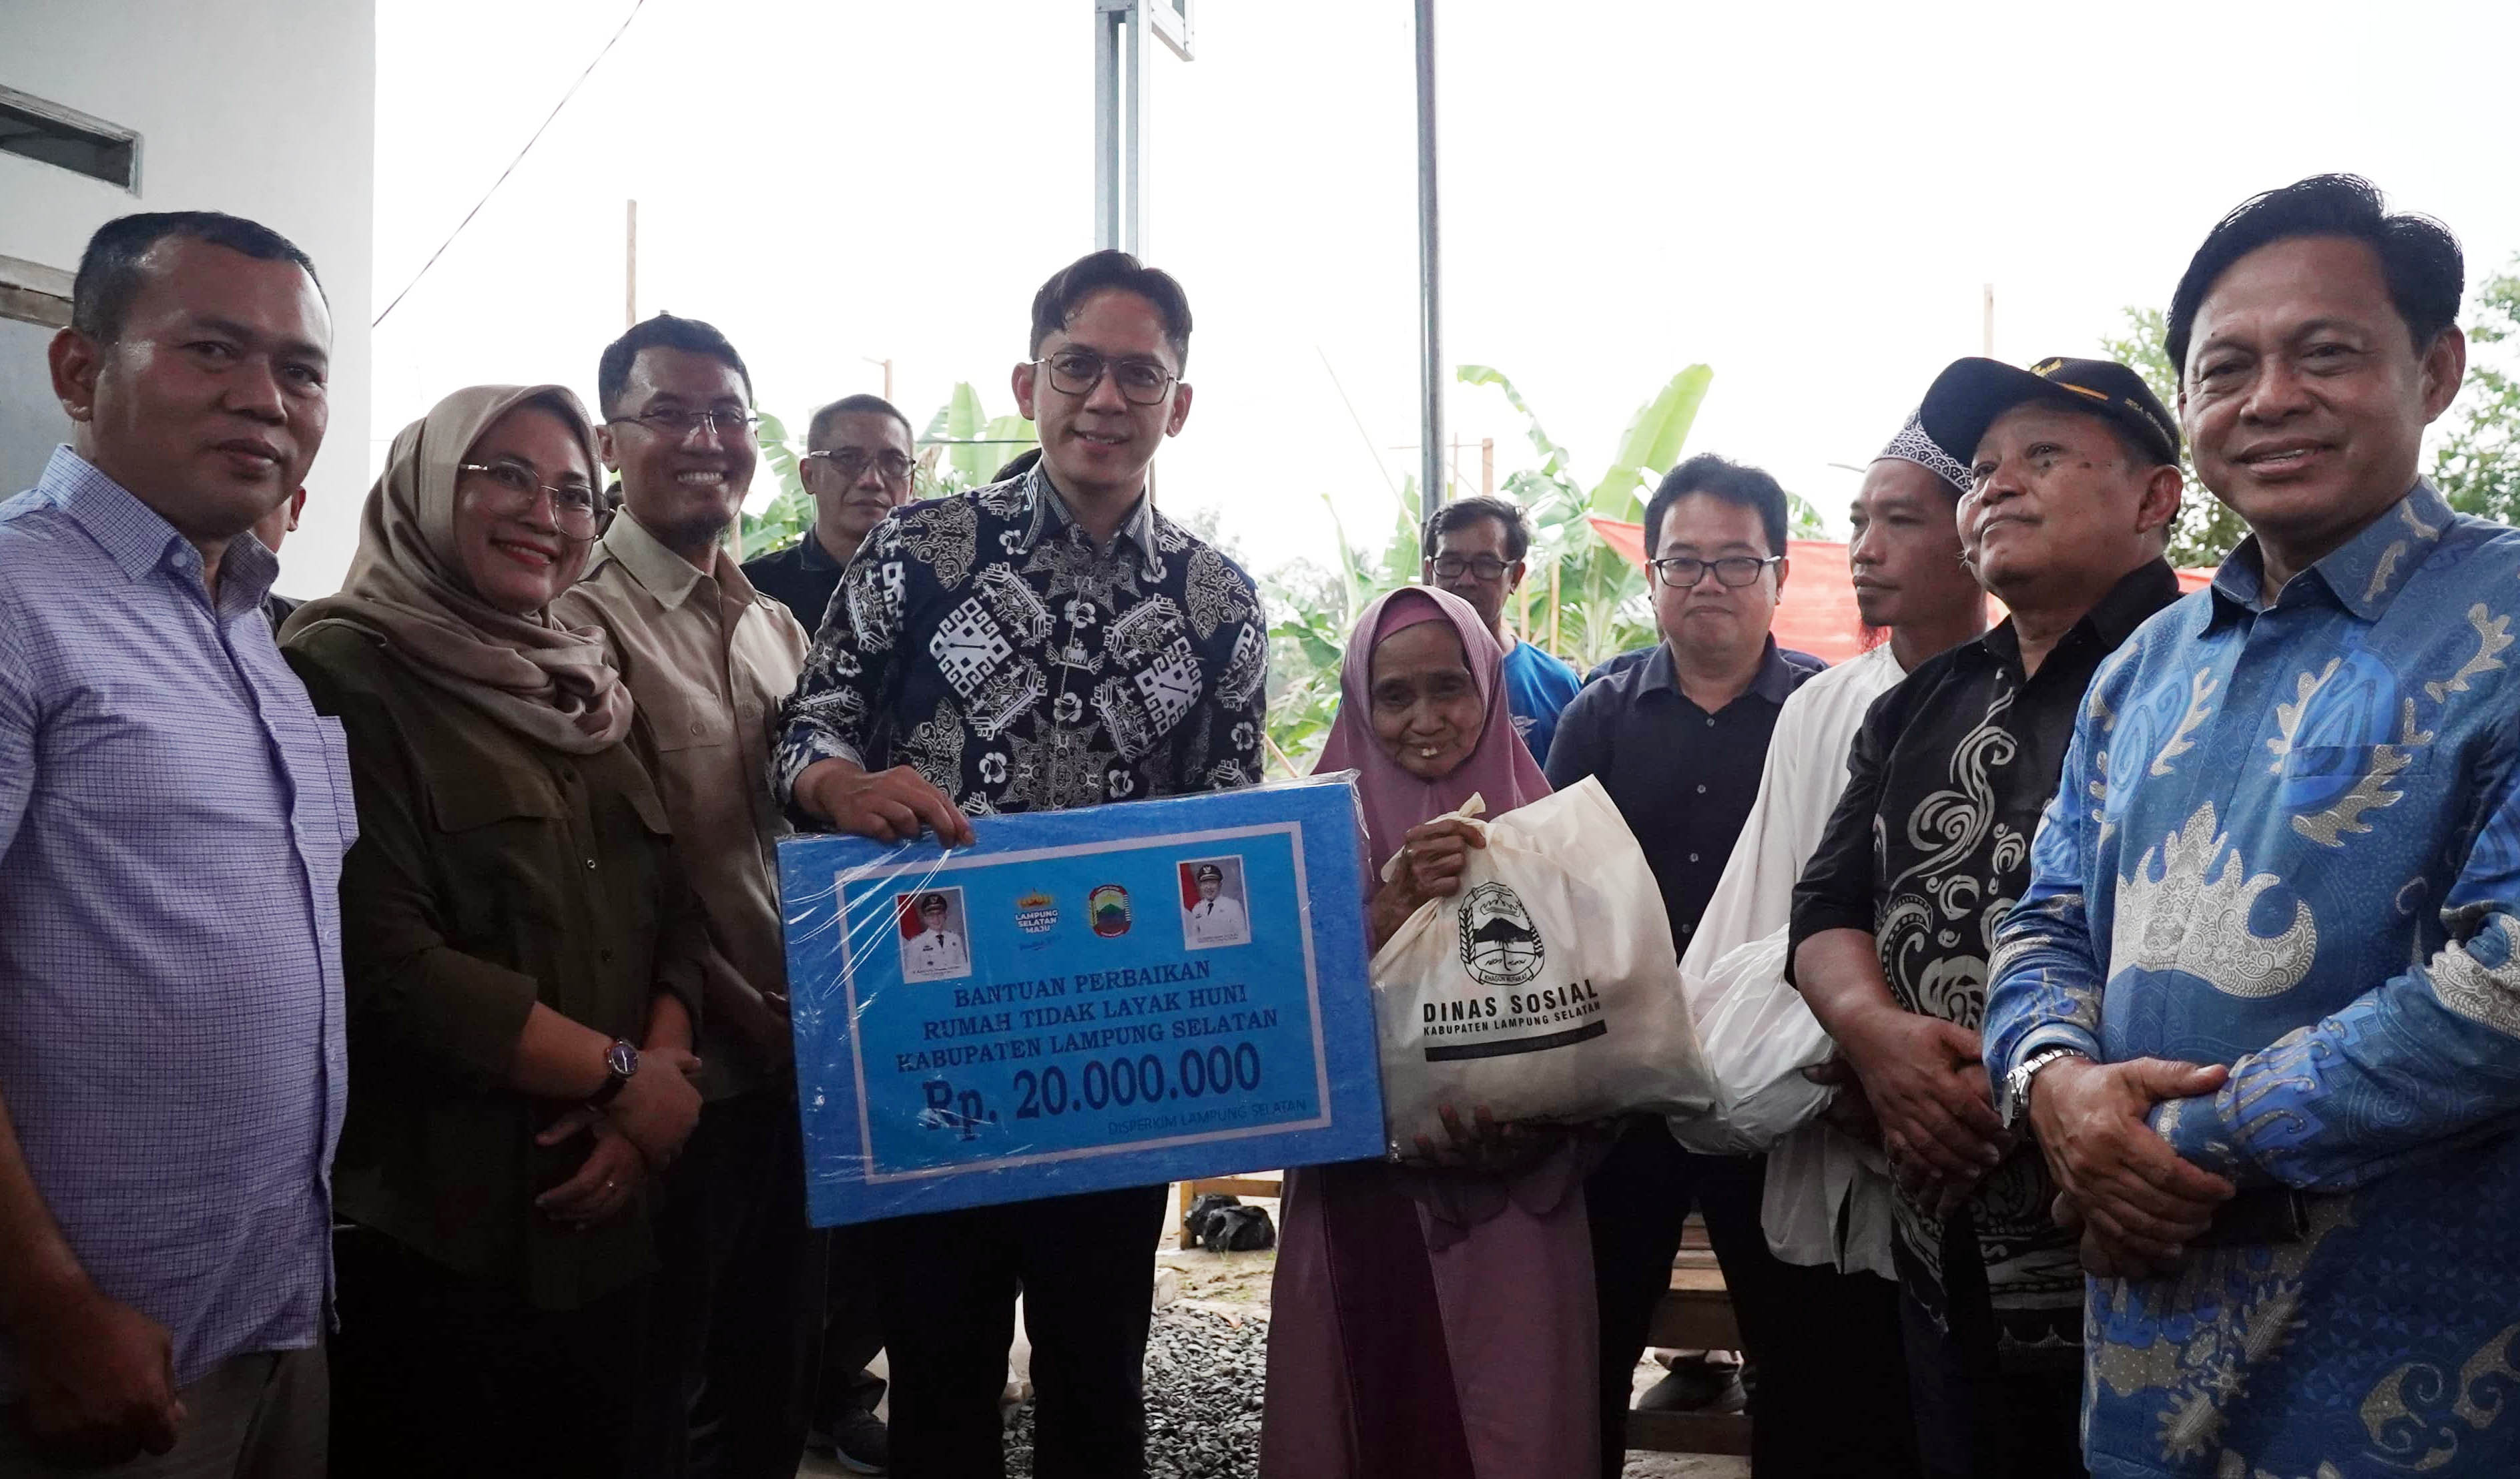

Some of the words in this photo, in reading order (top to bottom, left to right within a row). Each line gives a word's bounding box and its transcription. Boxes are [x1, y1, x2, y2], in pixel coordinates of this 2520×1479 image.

[1014, 909, 1058, 920] LAMPUNG
[1018, 917, 1057, 928] SELATAN
[1025, 925, 1050, 934] MAJU
[953, 977, 1066, 1008] BANTUAN
[1074, 960, 1210, 993] PERBAIKAN
[1424, 997, 1497, 1022] DINAS
[1510, 978, 1598, 1014] SOSIAL
[923, 1012, 1012, 1041] RUMAH
[1020, 1002, 1096, 1028] TIDAK
[1102, 992, 1182, 1018] LAYAK
[1188, 984, 1247, 1008] HUNI
[1424, 1022, 1488, 1037] KABUPATEN
[1494, 1015, 1548, 1030] LAMPUNG
[1554, 1001, 1601, 1021] SELATAN
[896, 1037, 1042, 1073] KABUPATEN
[1049, 1022, 1165, 1055] LAMPUNG
[1172, 1008, 1278, 1039] SELATAN
[922, 1079, 997, 1141] Rp.
[1014, 1041, 1261, 1119] 20.000.000
[1108, 1115, 1177, 1134] DISPERKIM
[1181, 1107, 1247, 1126] LAMPUNG
[1251, 1099, 1307, 1117] SELATAN
